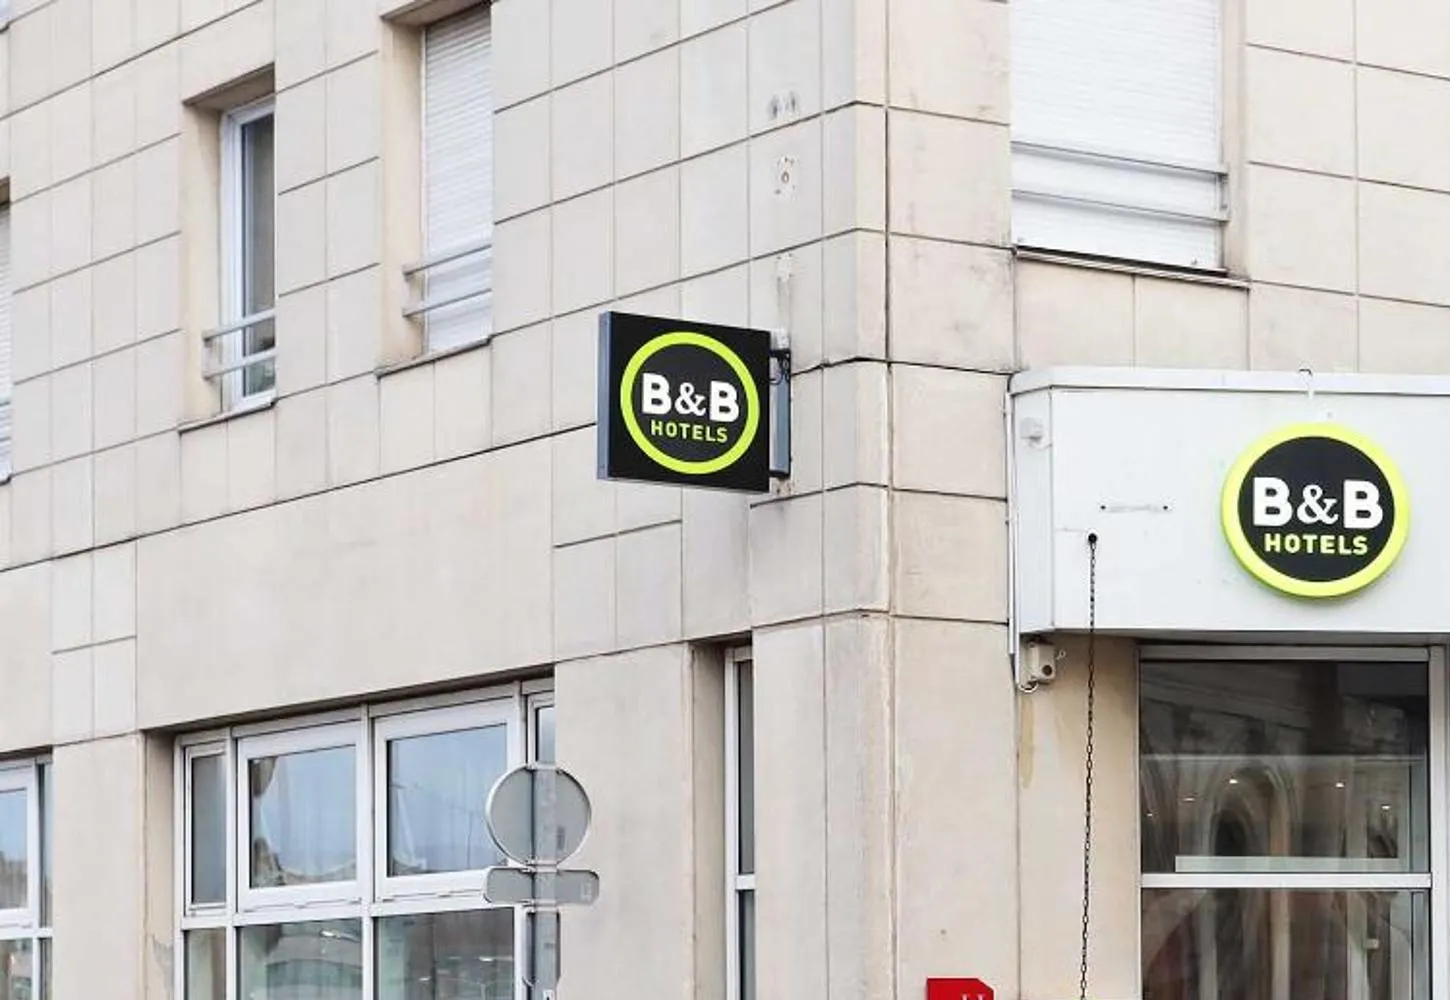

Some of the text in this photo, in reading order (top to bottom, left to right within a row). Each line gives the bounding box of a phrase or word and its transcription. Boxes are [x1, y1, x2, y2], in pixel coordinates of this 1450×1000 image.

[642, 373, 739, 422] B&B
[651, 420, 727, 442] HOTELS
[1253, 477, 1383, 529] B&B
[1264, 533, 1368, 555] HOTELS
